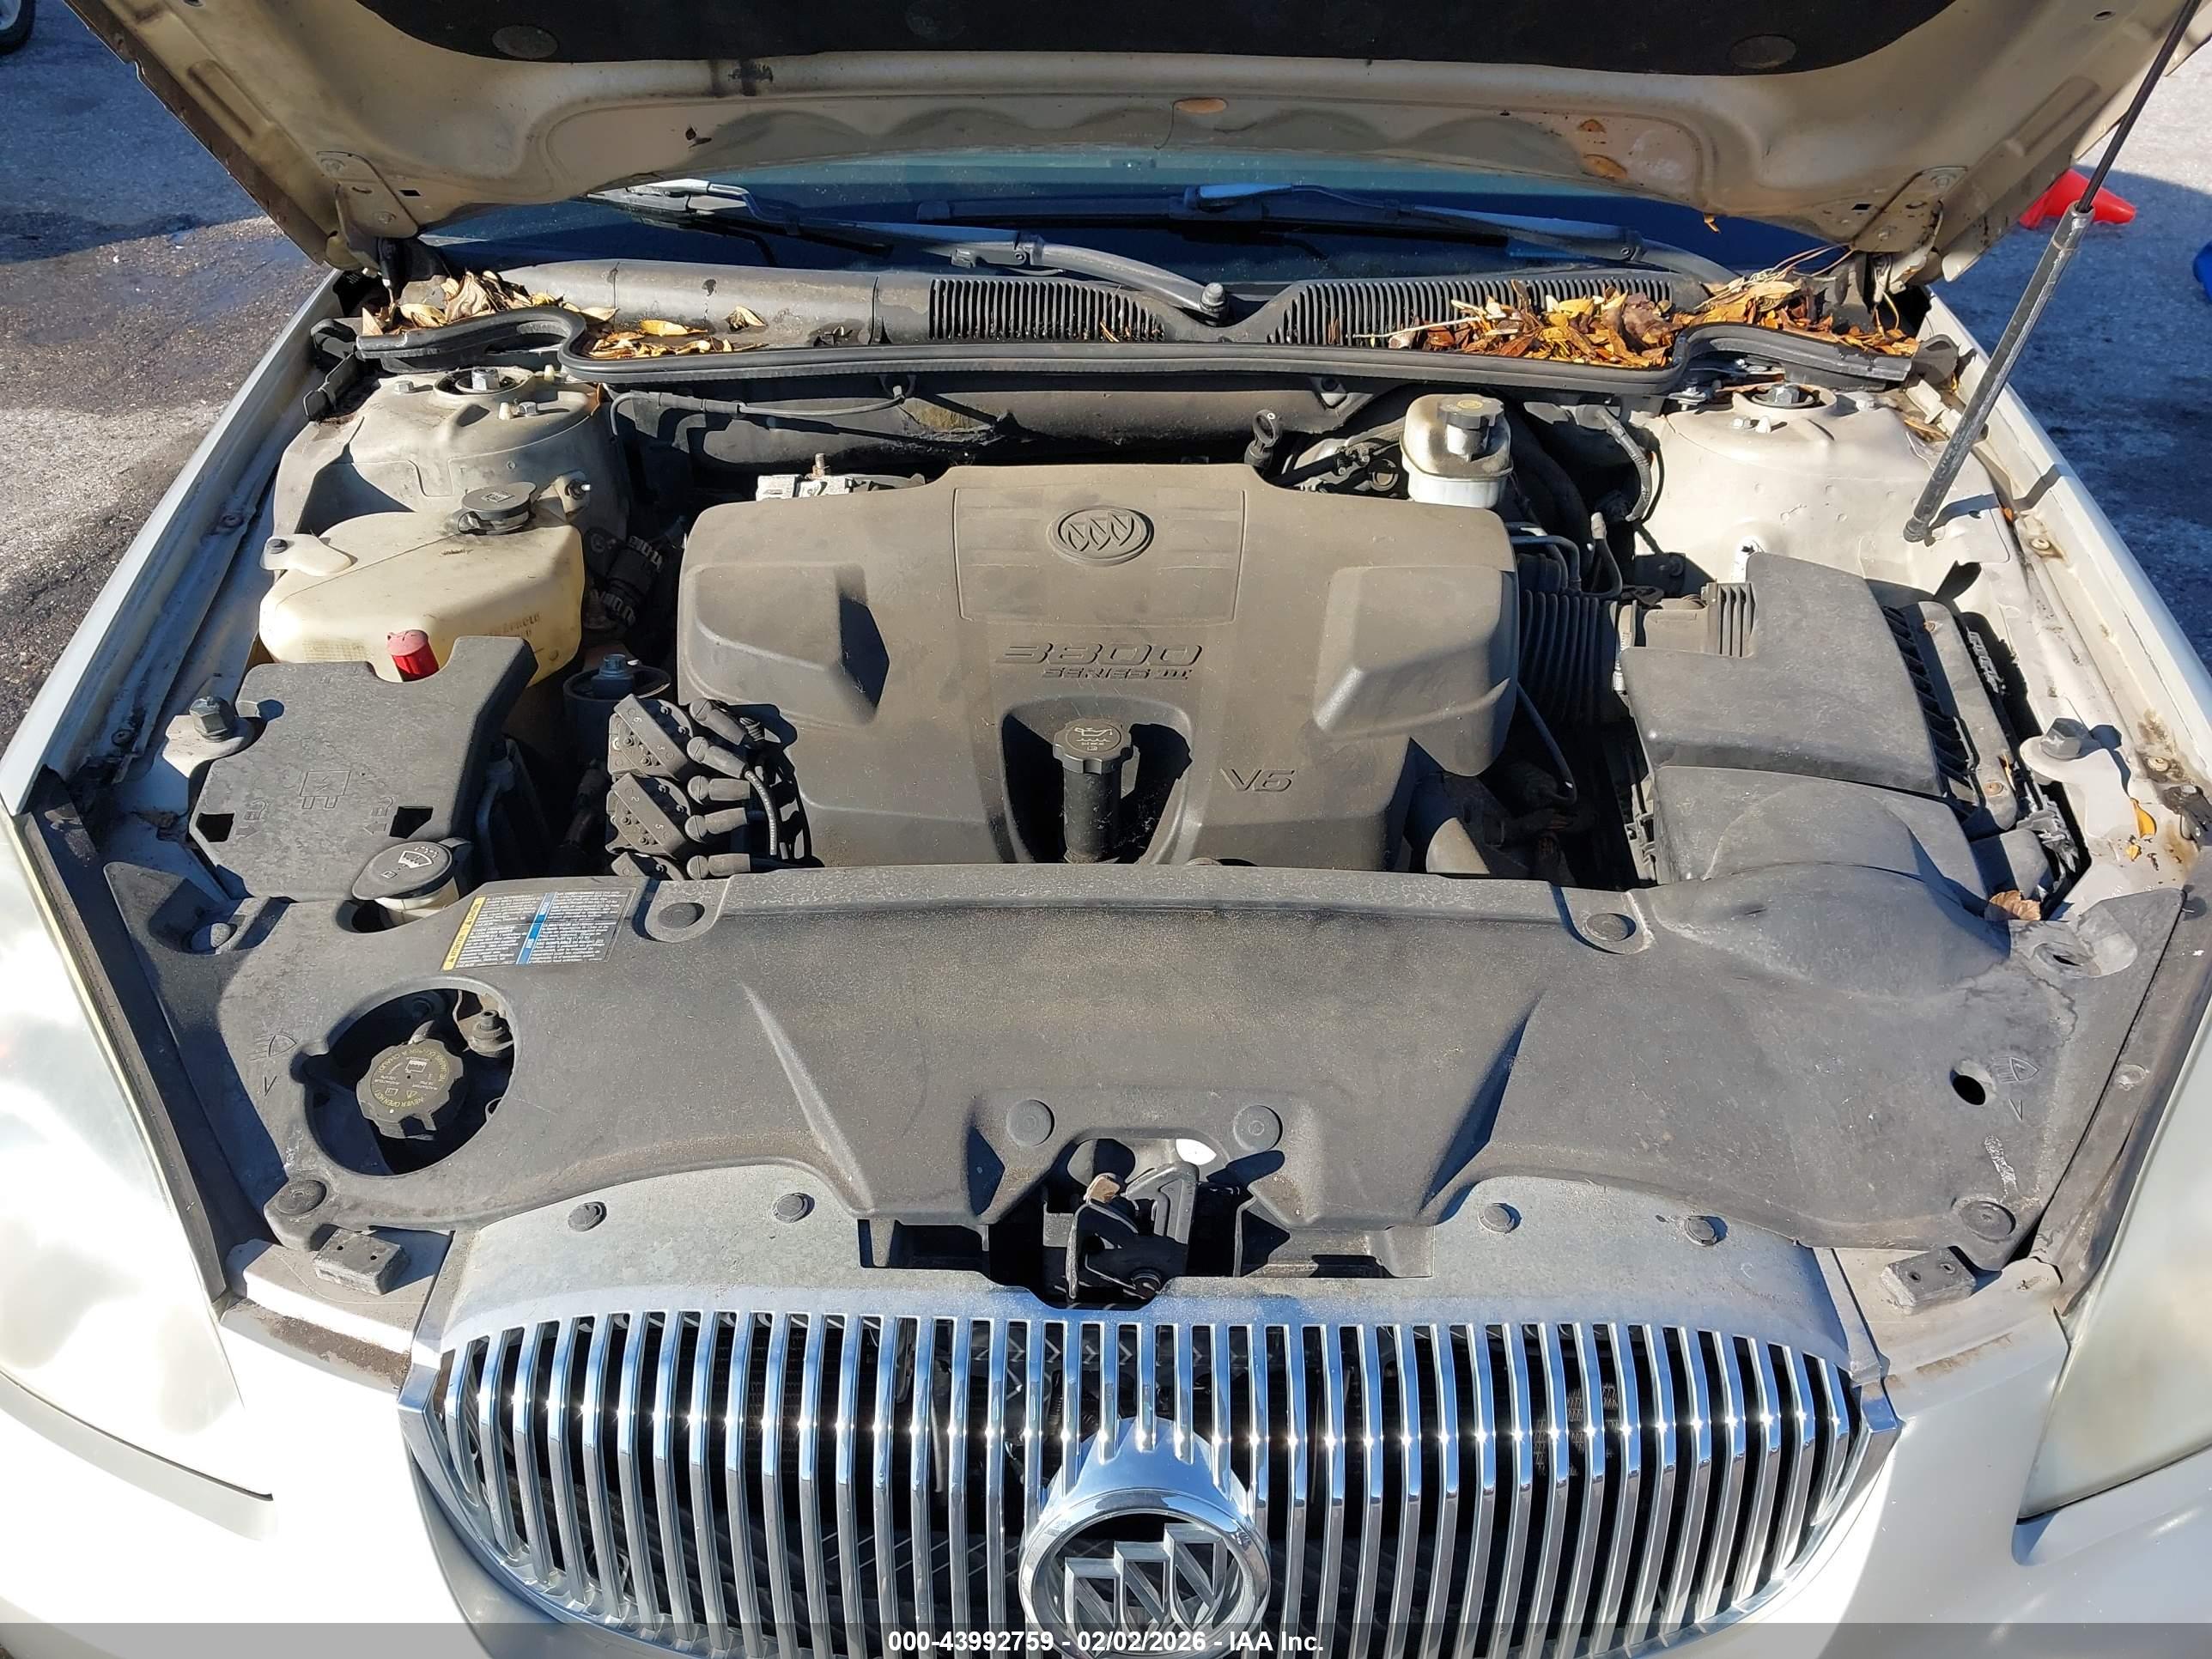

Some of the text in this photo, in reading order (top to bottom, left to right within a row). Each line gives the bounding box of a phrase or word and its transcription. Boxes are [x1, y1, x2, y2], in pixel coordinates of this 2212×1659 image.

[995, 643, 1202, 667] 3800
[1042, 667, 1151, 680] SERIES
[1220, 769, 1296, 793] V6
